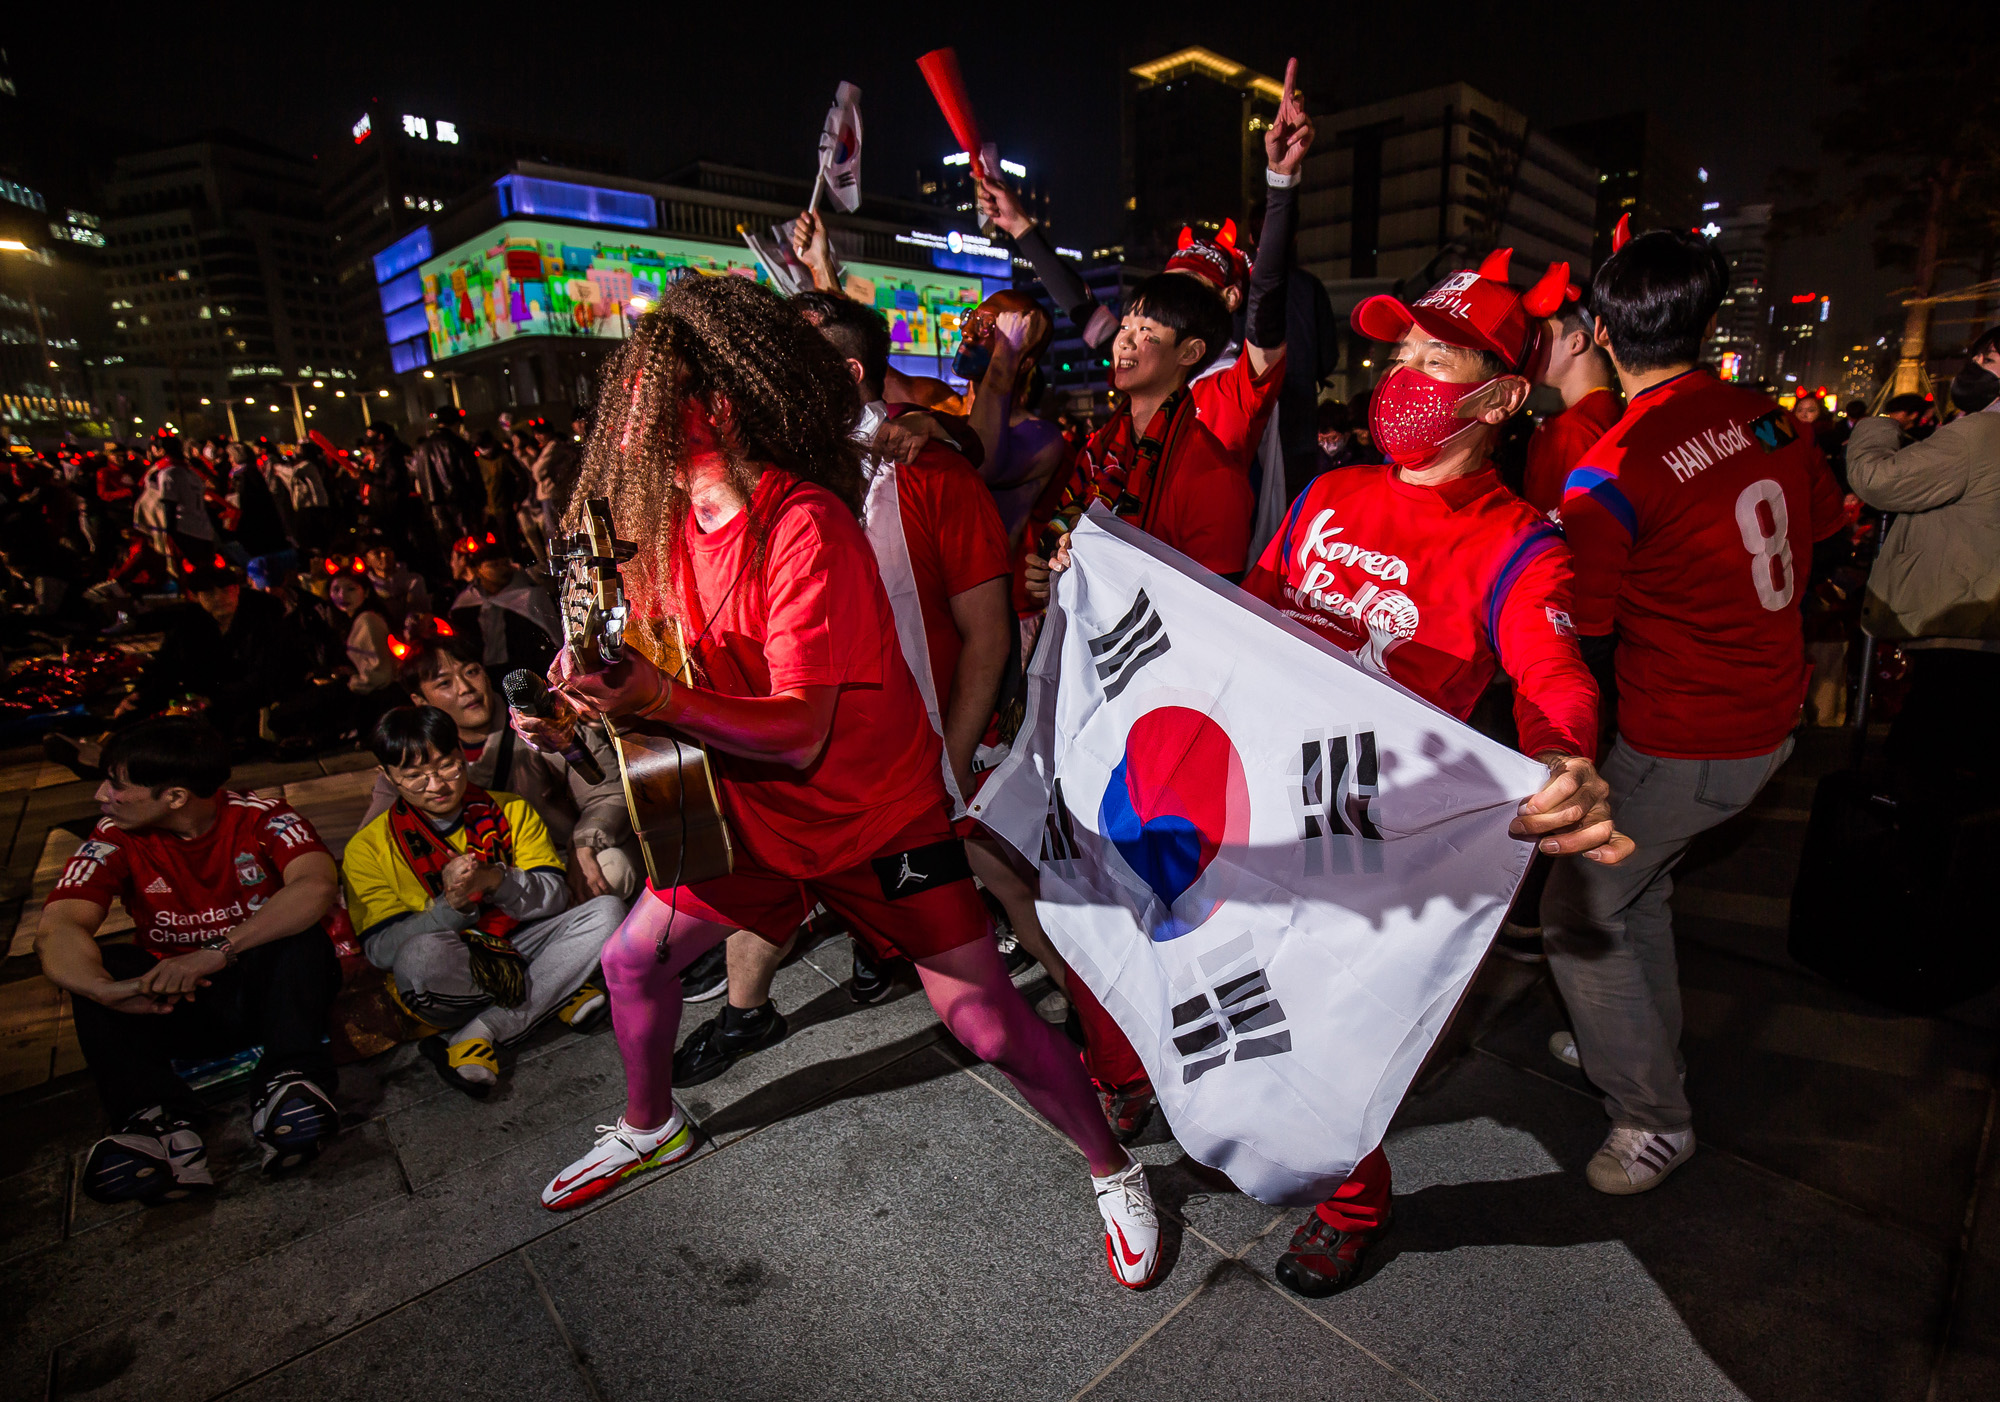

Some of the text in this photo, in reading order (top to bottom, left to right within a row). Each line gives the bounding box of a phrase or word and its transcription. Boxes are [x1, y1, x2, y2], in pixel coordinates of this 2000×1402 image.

[1662, 419, 1751, 483] HAN Kook
[1299, 508, 1409, 585] Korea
[1735, 479, 1794, 611] 8
[1296, 562, 1379, 632] Red
[155, 901, 243, 927] Standard
